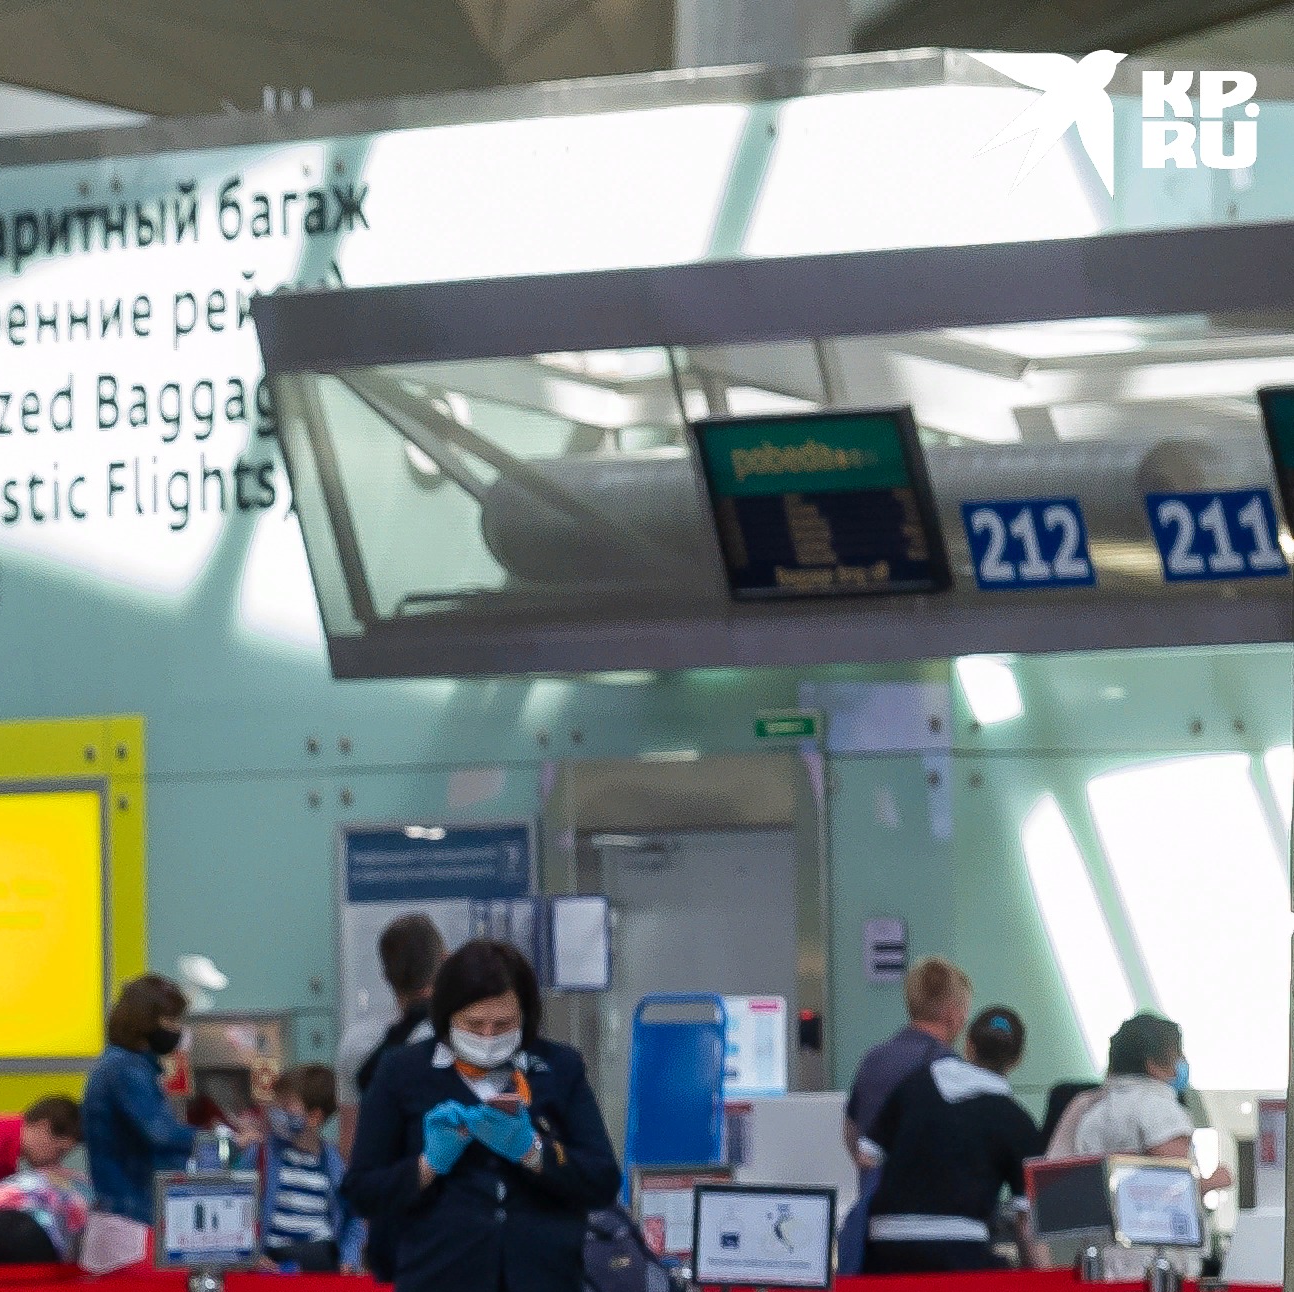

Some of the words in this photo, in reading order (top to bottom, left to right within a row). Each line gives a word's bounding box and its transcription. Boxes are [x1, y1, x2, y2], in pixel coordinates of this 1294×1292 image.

[218, 177, 369, 239] багаж
[172, 270, 257, 349] рей
[96, 374, 276, 443] Baggag
[971, 506, 1087, 583] 212
[1157, 497, 1278, 575] 211
